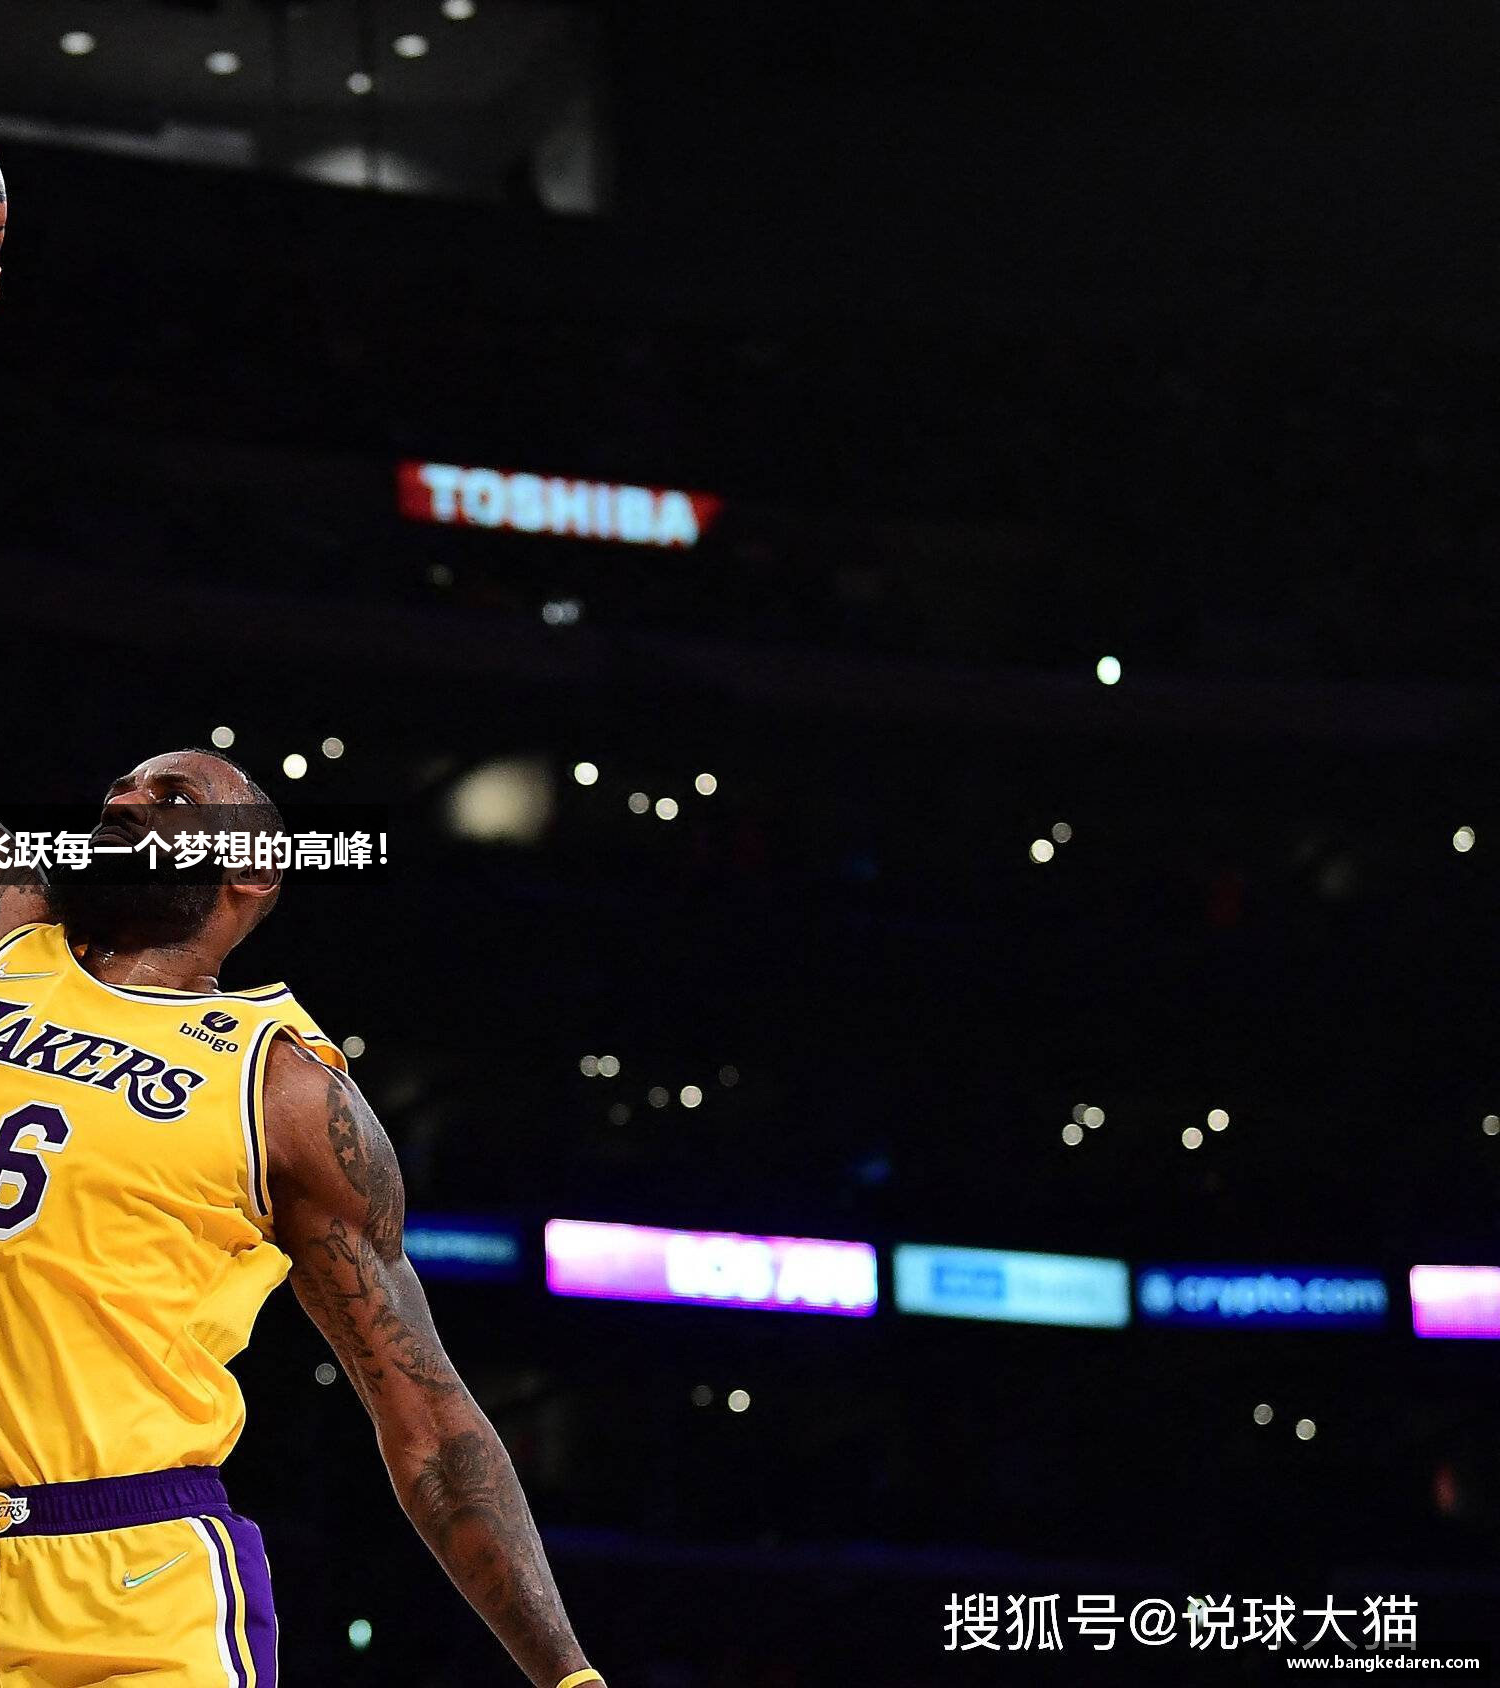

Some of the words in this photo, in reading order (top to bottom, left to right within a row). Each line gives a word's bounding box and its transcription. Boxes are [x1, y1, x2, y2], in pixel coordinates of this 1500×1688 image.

[420, 462, 699, 547] TOSHIBA
[179, 1022, 239, 1053] bibigo
[1175, 1272, 1388, 1318] crypto.com
